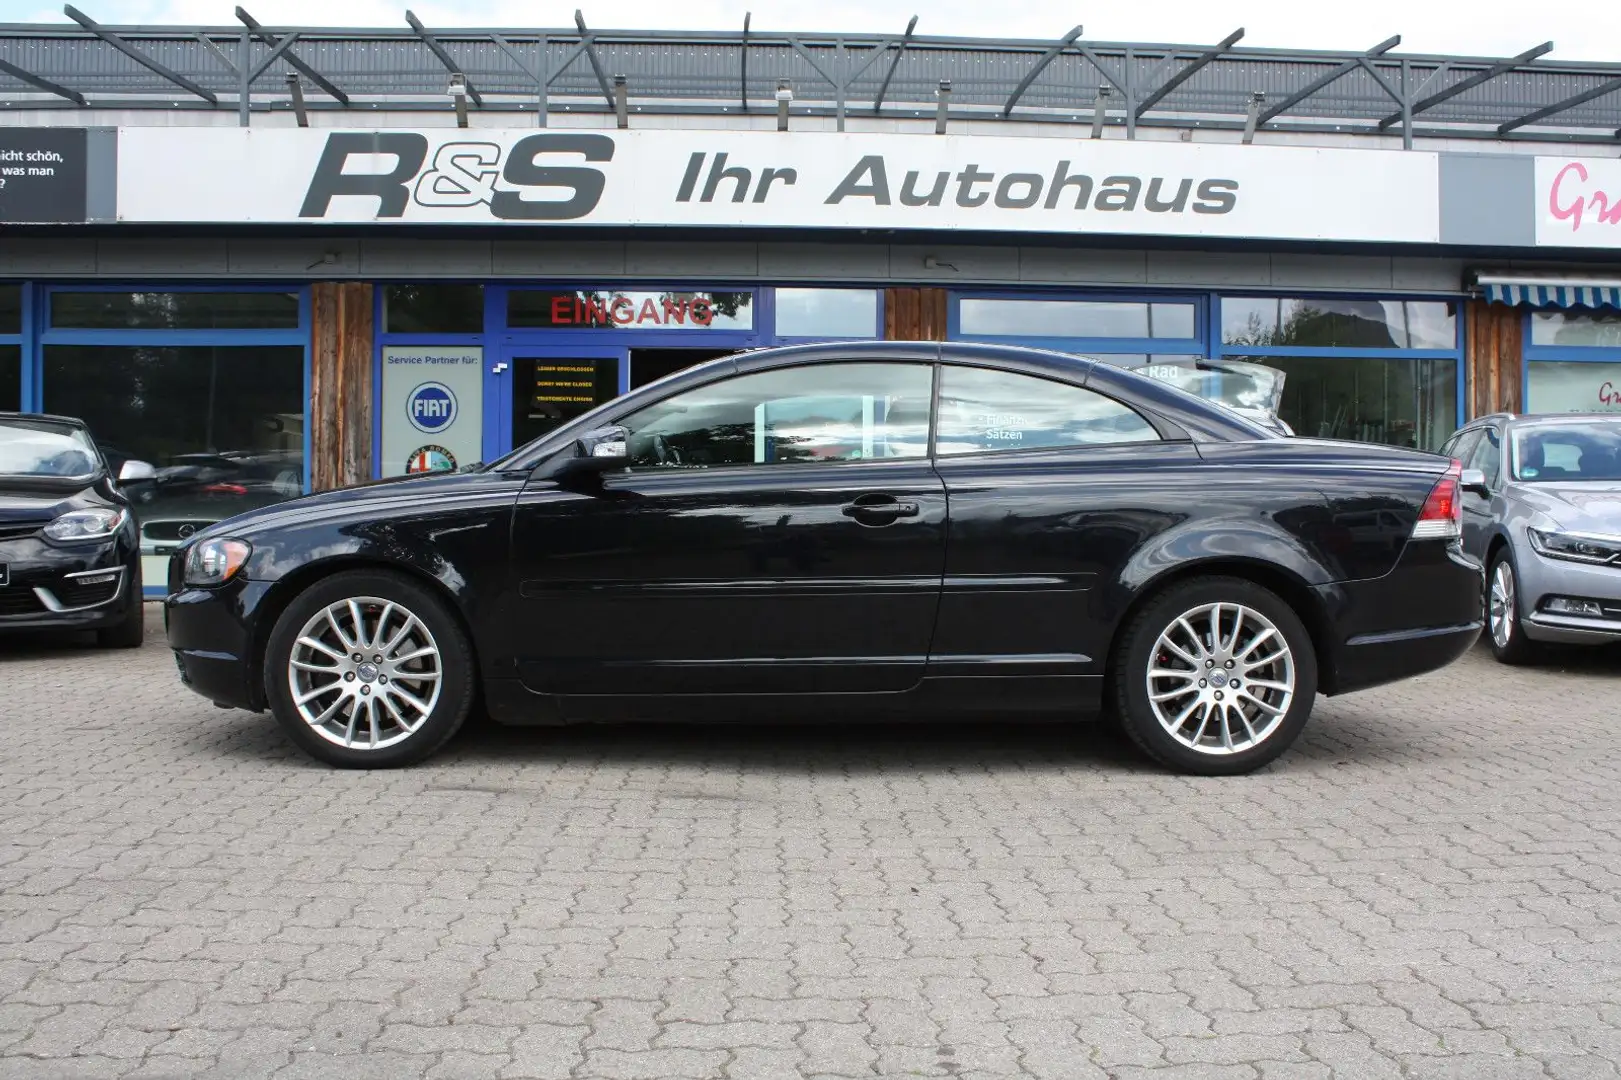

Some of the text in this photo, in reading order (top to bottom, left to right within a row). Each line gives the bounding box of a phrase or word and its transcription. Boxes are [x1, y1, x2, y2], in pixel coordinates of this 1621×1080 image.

[0, 150, 64, 163] icht schön,
[2, 167, 54, 176] was man
[298, 132, 1239, 220] R&S Ihr Autohaus
[551, 297, 713, 325] EINGANG
[387, 355, 478, 365] Service Partner für:
[1149, 366, 1177, 378] Rad
[414, 399, 450, 417] FIAT
